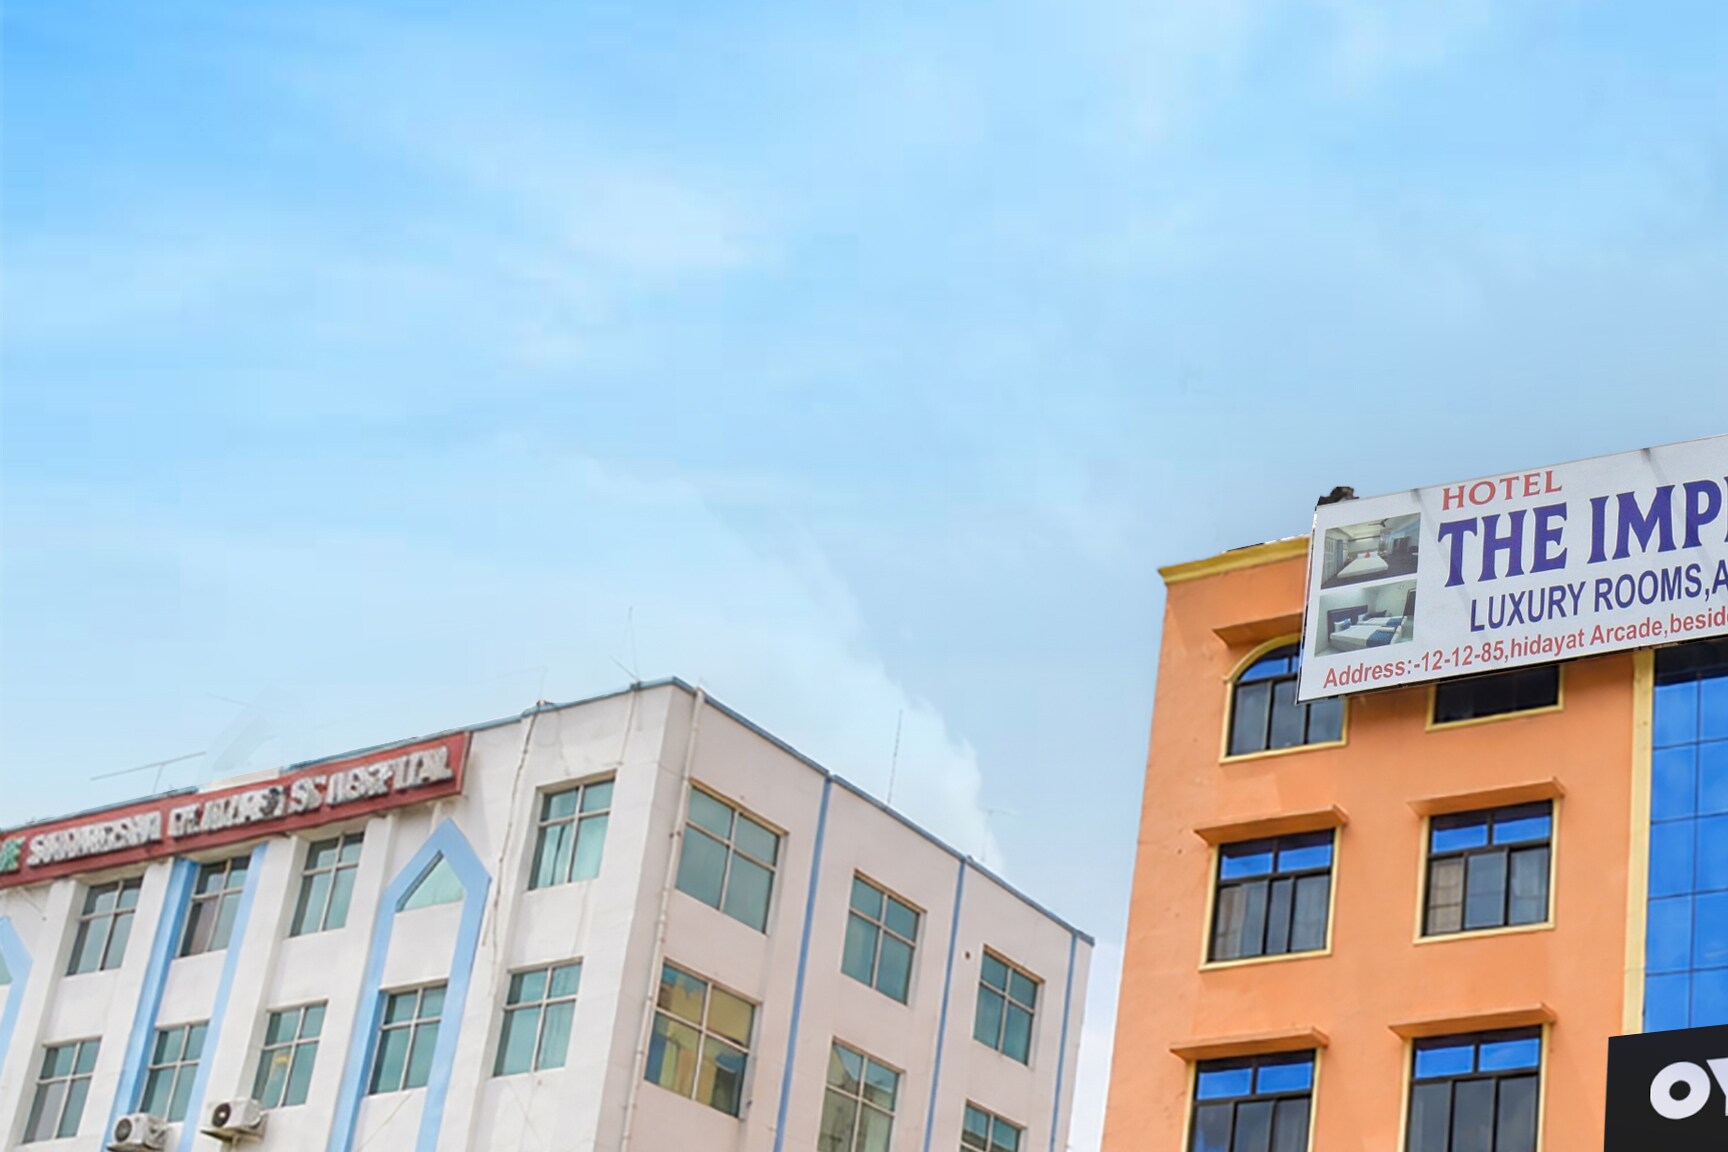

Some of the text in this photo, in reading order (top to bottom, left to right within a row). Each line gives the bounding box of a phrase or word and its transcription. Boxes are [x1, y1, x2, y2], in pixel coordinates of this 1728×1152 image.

[1442, 470, 1563, 510] HOTEL
[1438, 502, 1568, 587] THE
[1470, 580, 1587, 632] LUXURY
